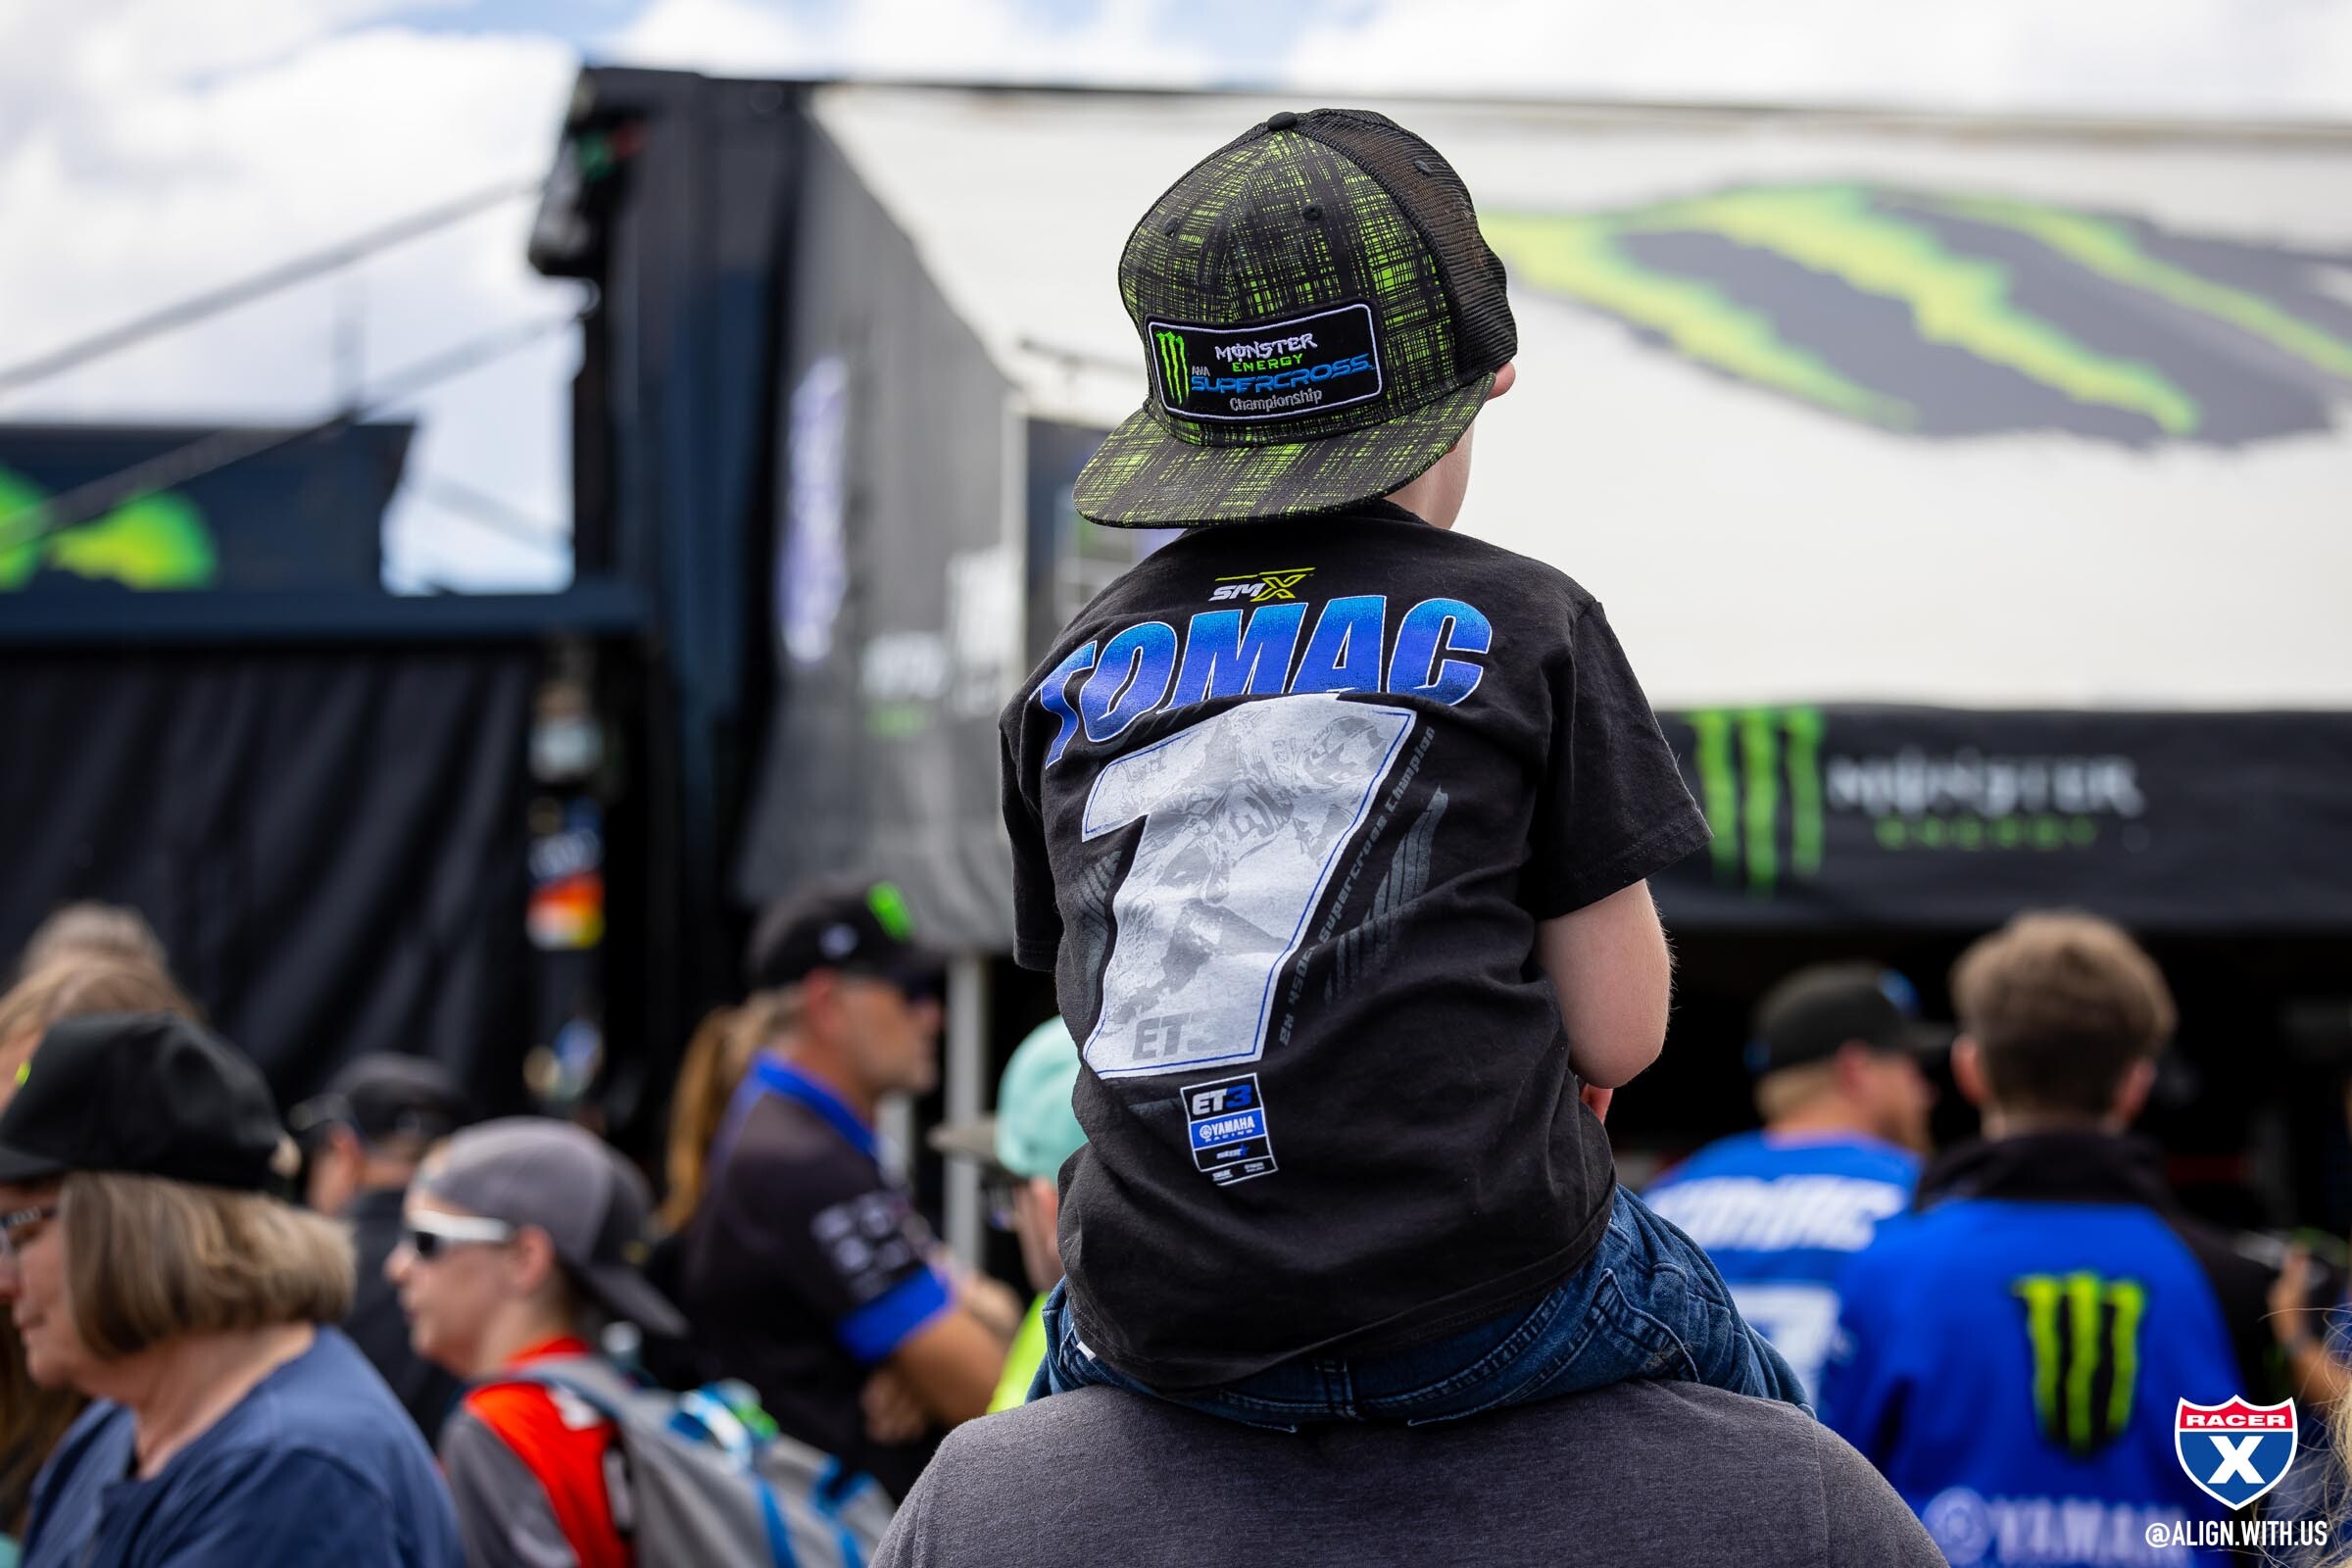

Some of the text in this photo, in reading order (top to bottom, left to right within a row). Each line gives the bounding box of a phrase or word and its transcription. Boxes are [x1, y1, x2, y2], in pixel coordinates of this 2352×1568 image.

[1215, 333, 1317, 363] MONSTER
[1191, 353, 1376, 393] SUPERCROSS
[1232, 354, 1303, 372] ENERGY
[1230, 388, 1323, 413] Championship
[1208, 574, 1307, 603] SMX
[1028, 595, 1493, 769] TOMAC
[1192, 1084, 1252, 1115] ET3
[1211, 1115, 1255, 1136] YAMAHA
